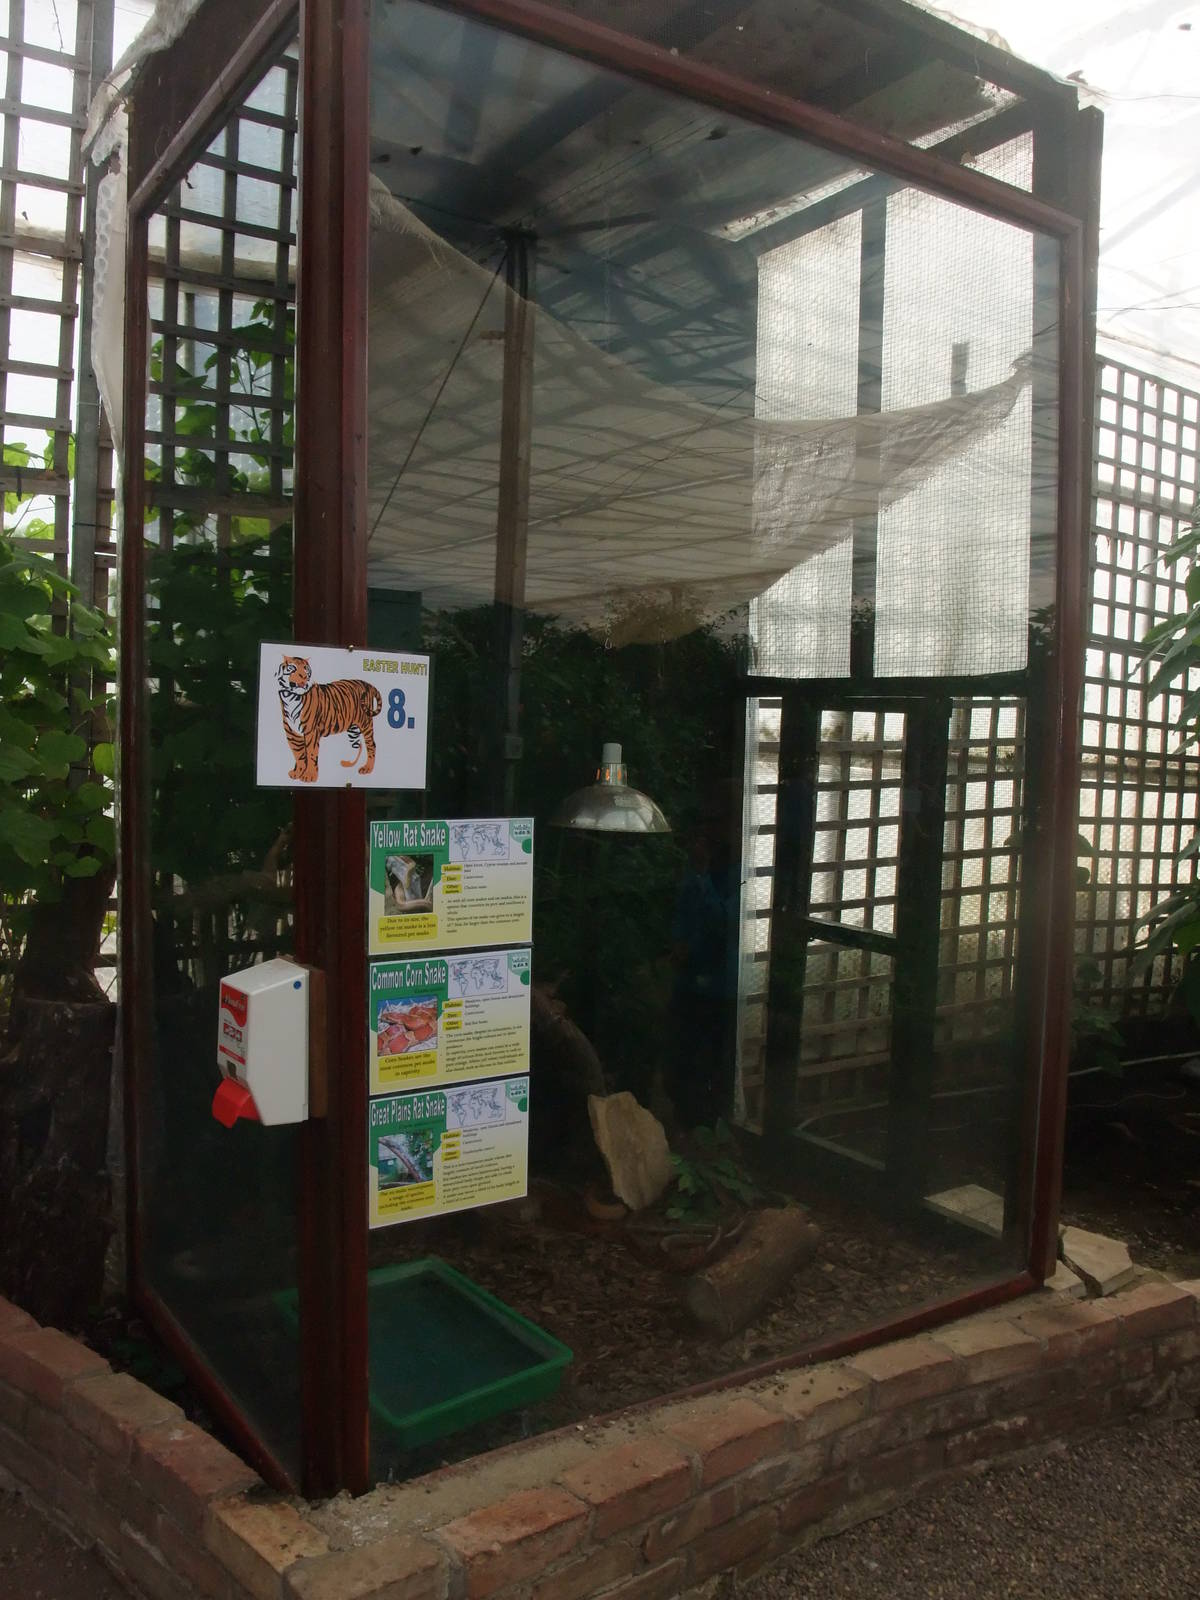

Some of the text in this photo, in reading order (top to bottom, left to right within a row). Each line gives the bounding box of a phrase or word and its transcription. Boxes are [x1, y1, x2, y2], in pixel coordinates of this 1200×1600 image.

[362, 658, 399, 674] EASTER
[387, 688, 416, 730] 8.
[373, 822, 446, 849] Yellow Rat Snake
[372, 961, 447, 991] Common Corn Snake
[371, 1094, 445, 1127] Great Plains Rat Snake
